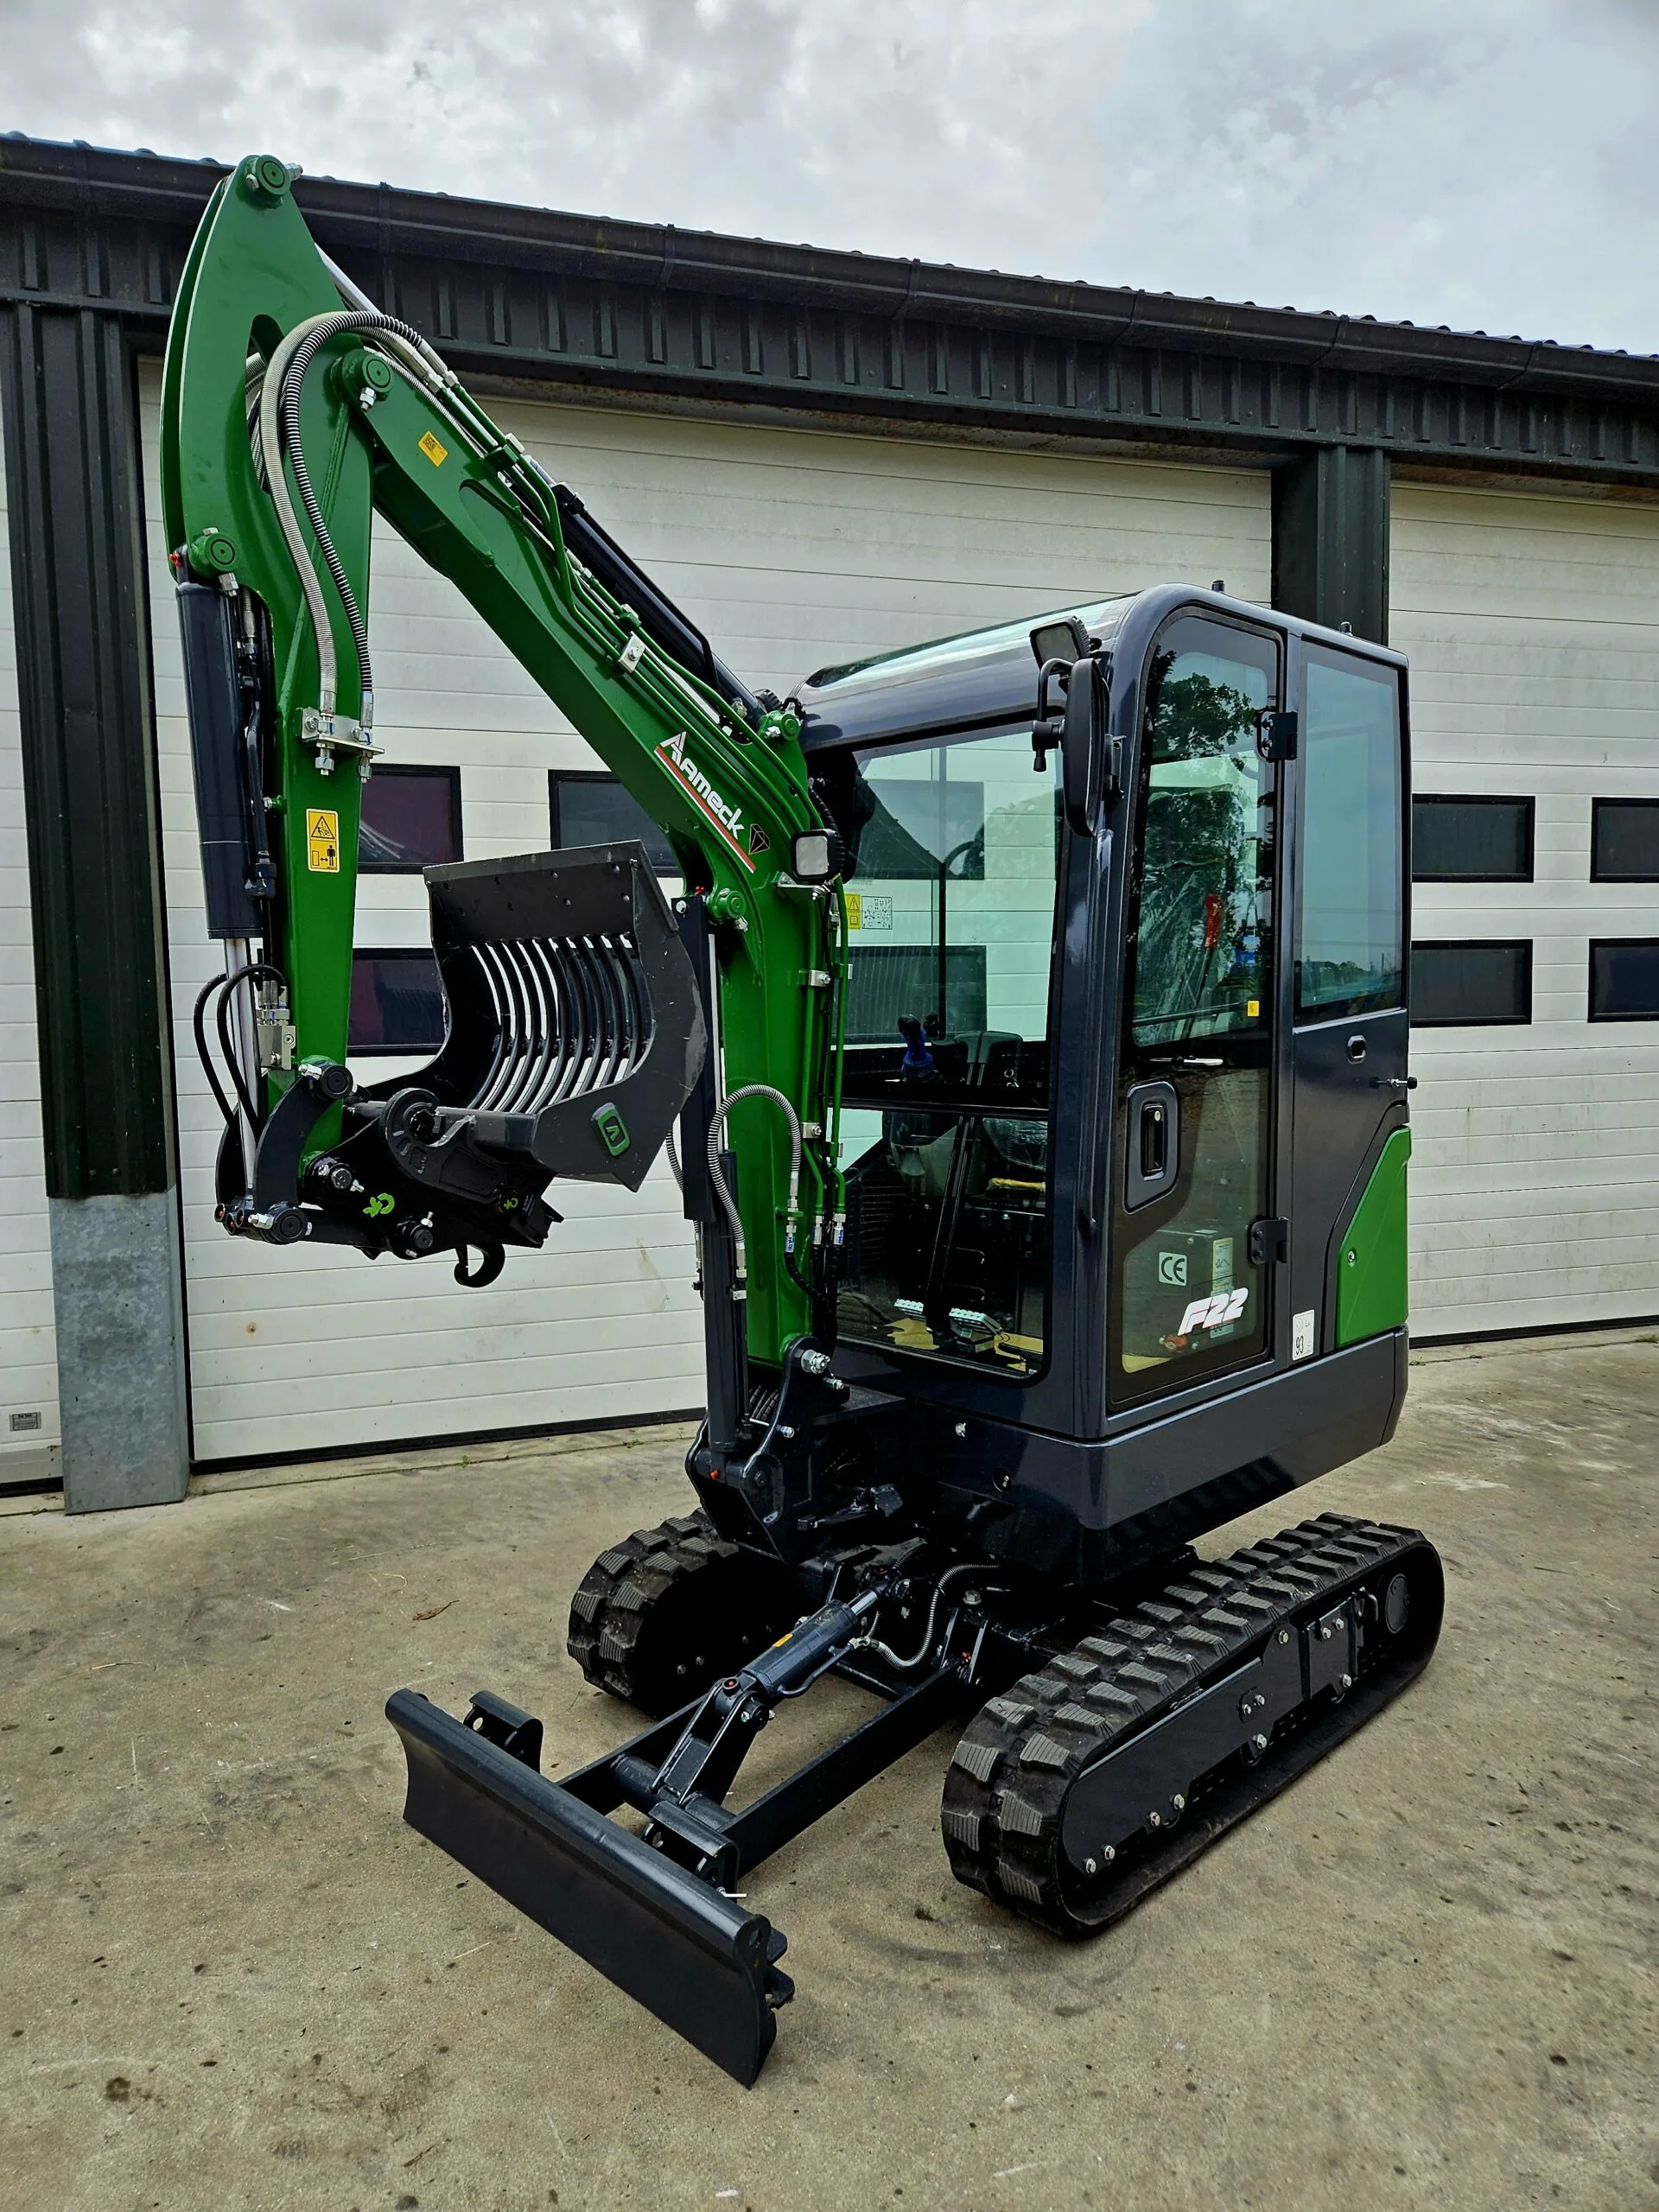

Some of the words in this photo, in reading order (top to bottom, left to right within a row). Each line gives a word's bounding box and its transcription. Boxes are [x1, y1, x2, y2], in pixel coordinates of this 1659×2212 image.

[1160, 1255, 1185, 1283] CE
[1177, 1287, 1249, 1337] F22
[1295, 1335, 1305, 1356] 93
